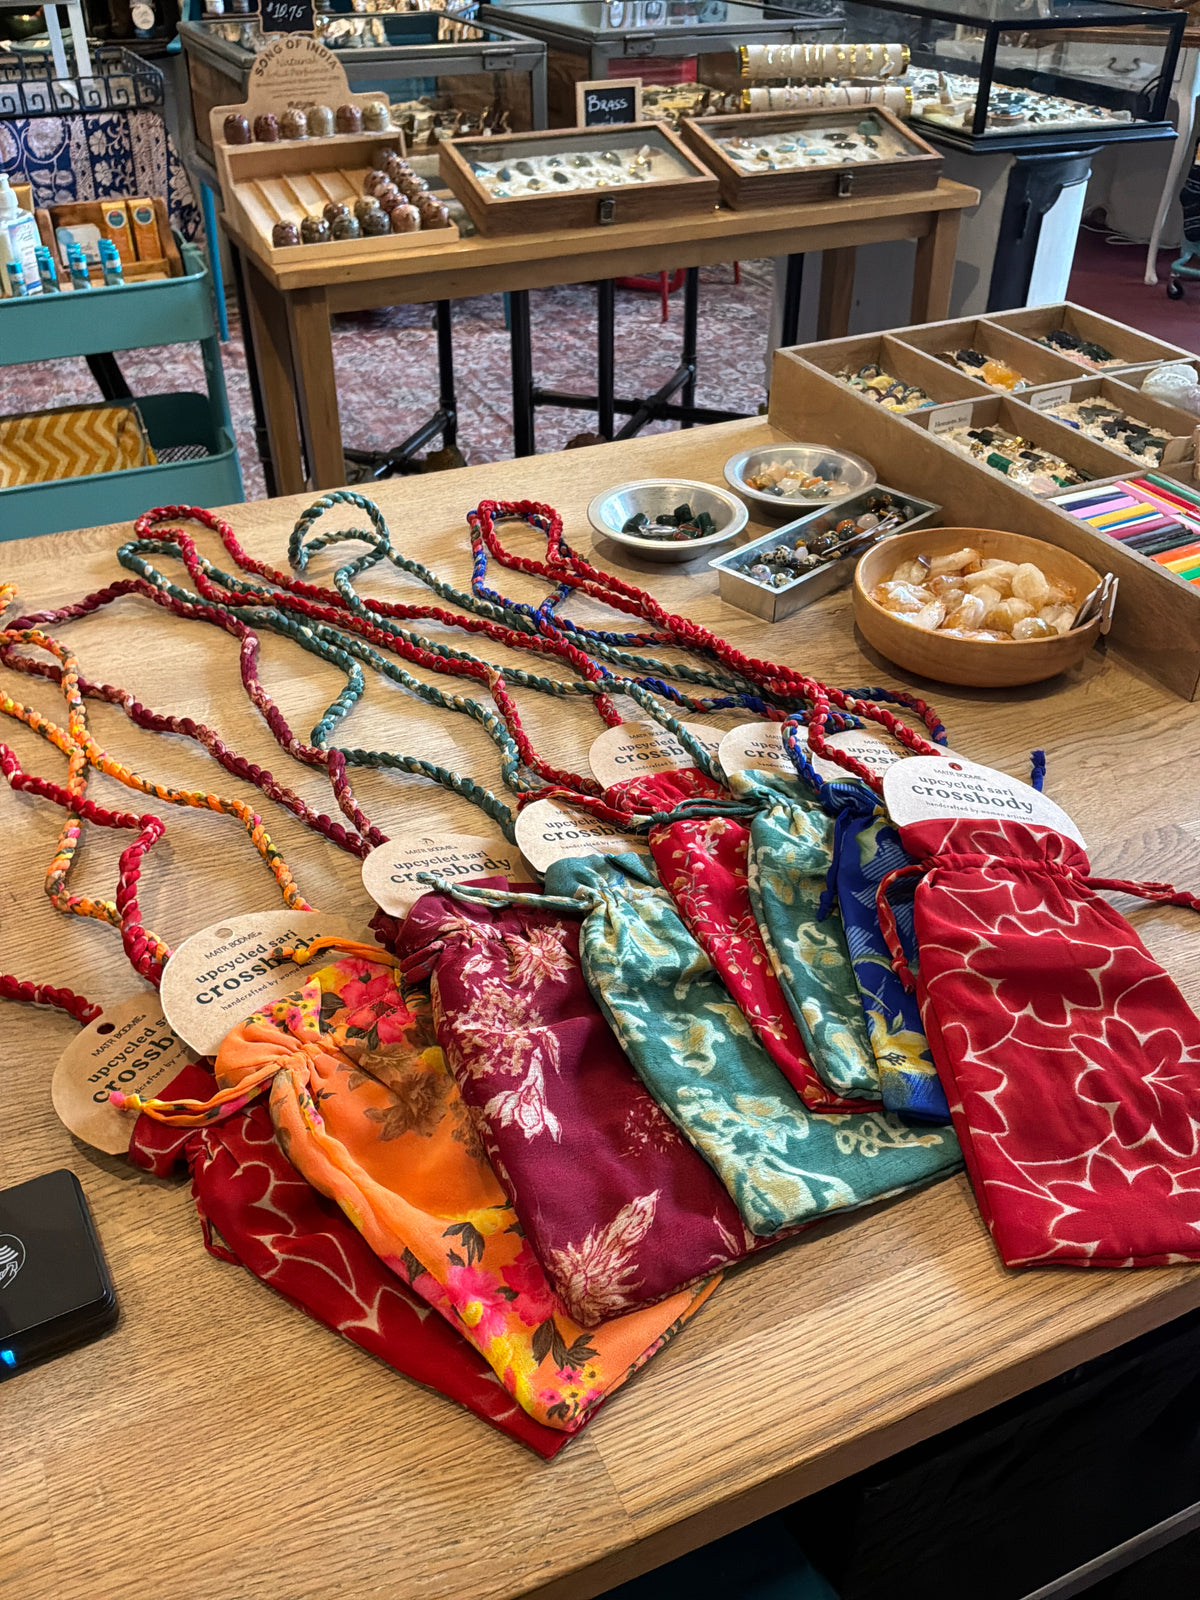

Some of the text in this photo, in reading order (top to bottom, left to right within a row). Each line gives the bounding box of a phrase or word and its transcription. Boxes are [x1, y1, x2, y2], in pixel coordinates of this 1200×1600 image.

[255, 44, 283, 77] SONG
[286, 39, 302, 50] OF
[306, 40, 338, 71] INDIA
[614, 740, 720, 765] crossbdy
[618, 738, 676, 753] upcycled
[911, 784, 1034, 814] crossbody
[918, 776, 1014, 797] upcycled sari
[390, 857, 512, 885] crssbody
[393, 850, 489, 871] upcycled sari
[194, 944, 269, 984] upcycled
[268, 929, 299, 949] sari
[204, 944, 229, 960] MATR
[220, 983, 268, 1012] handcrafted
[87, 1027, 157, 1084] upcycled
[91, 1037, 117, 1058] MATR
